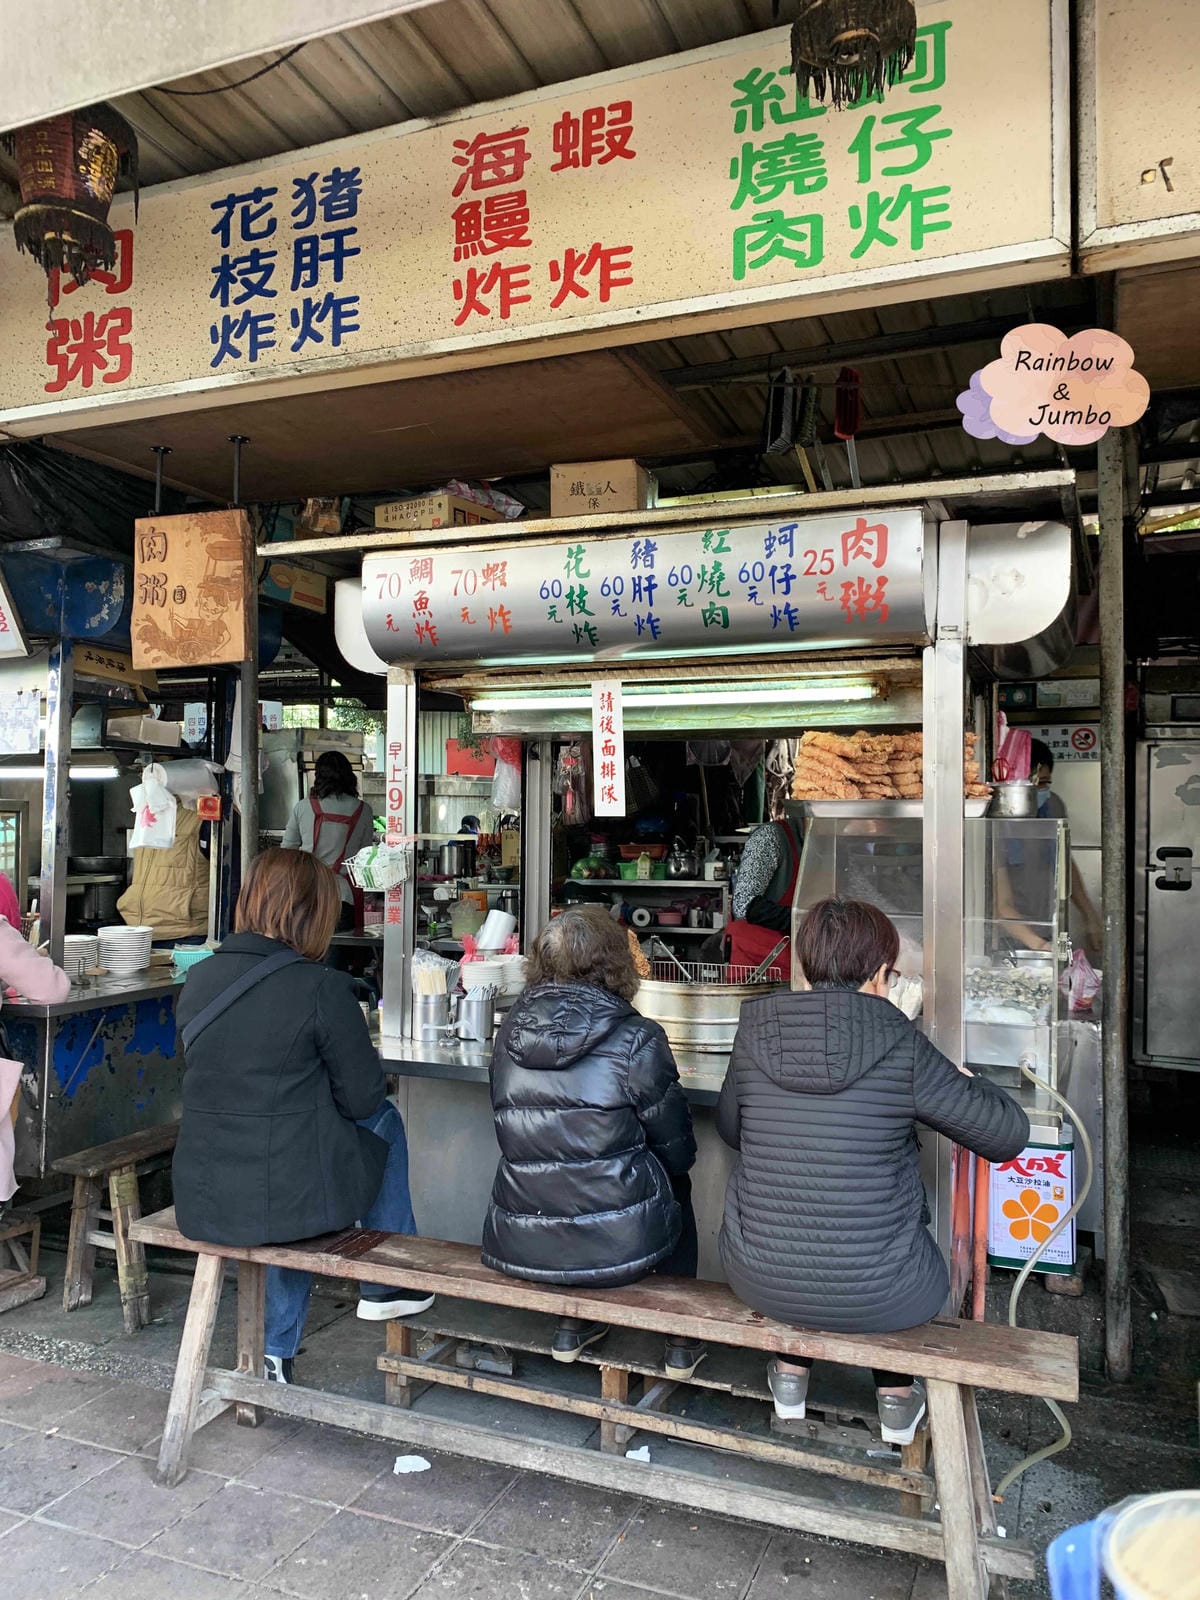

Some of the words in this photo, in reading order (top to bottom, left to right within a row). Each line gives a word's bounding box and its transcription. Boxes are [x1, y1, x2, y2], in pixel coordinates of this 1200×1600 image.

[730, 67, 828, 281] 紅燒肉
[452, 127, 532, 327] 海鰻炸
[210, 187, 278, 368] 花枝炸
[667, 564, 693, 587] 60
[738, 561, 765, 584] 60
[803, 548, 835, 576] 25
[839, 517, 889, 625] 肉粥
[376, 573, 401, 600] 70
[451, 569, 477, 596] 70
[539, 579, 562, 599] 60
[600, 576, 625, 597] 60
[631, 538, 662, 640] 豬肝炸
[697, 528, 732, 630] 紅燒肉
[764, 523, 800, 632] 蚵仔炸
[816, 581, 835, 601] 元
[408, 557, 440, 647] 鯛魚炸
[481, 561, 513, 636] 蝦炸
[563, 544, 600, 647] 花枝炸
[611, 599, 628, 617] 元
[677, 588, 695, 607] 元
[747, 586, 765, 606] 元
[386, 614, 400, 633] 元
[460, 607, 476, 625] 元
[547, 605, 563, 624] 元
[599, 691, 619, 804] 請後面排隊
